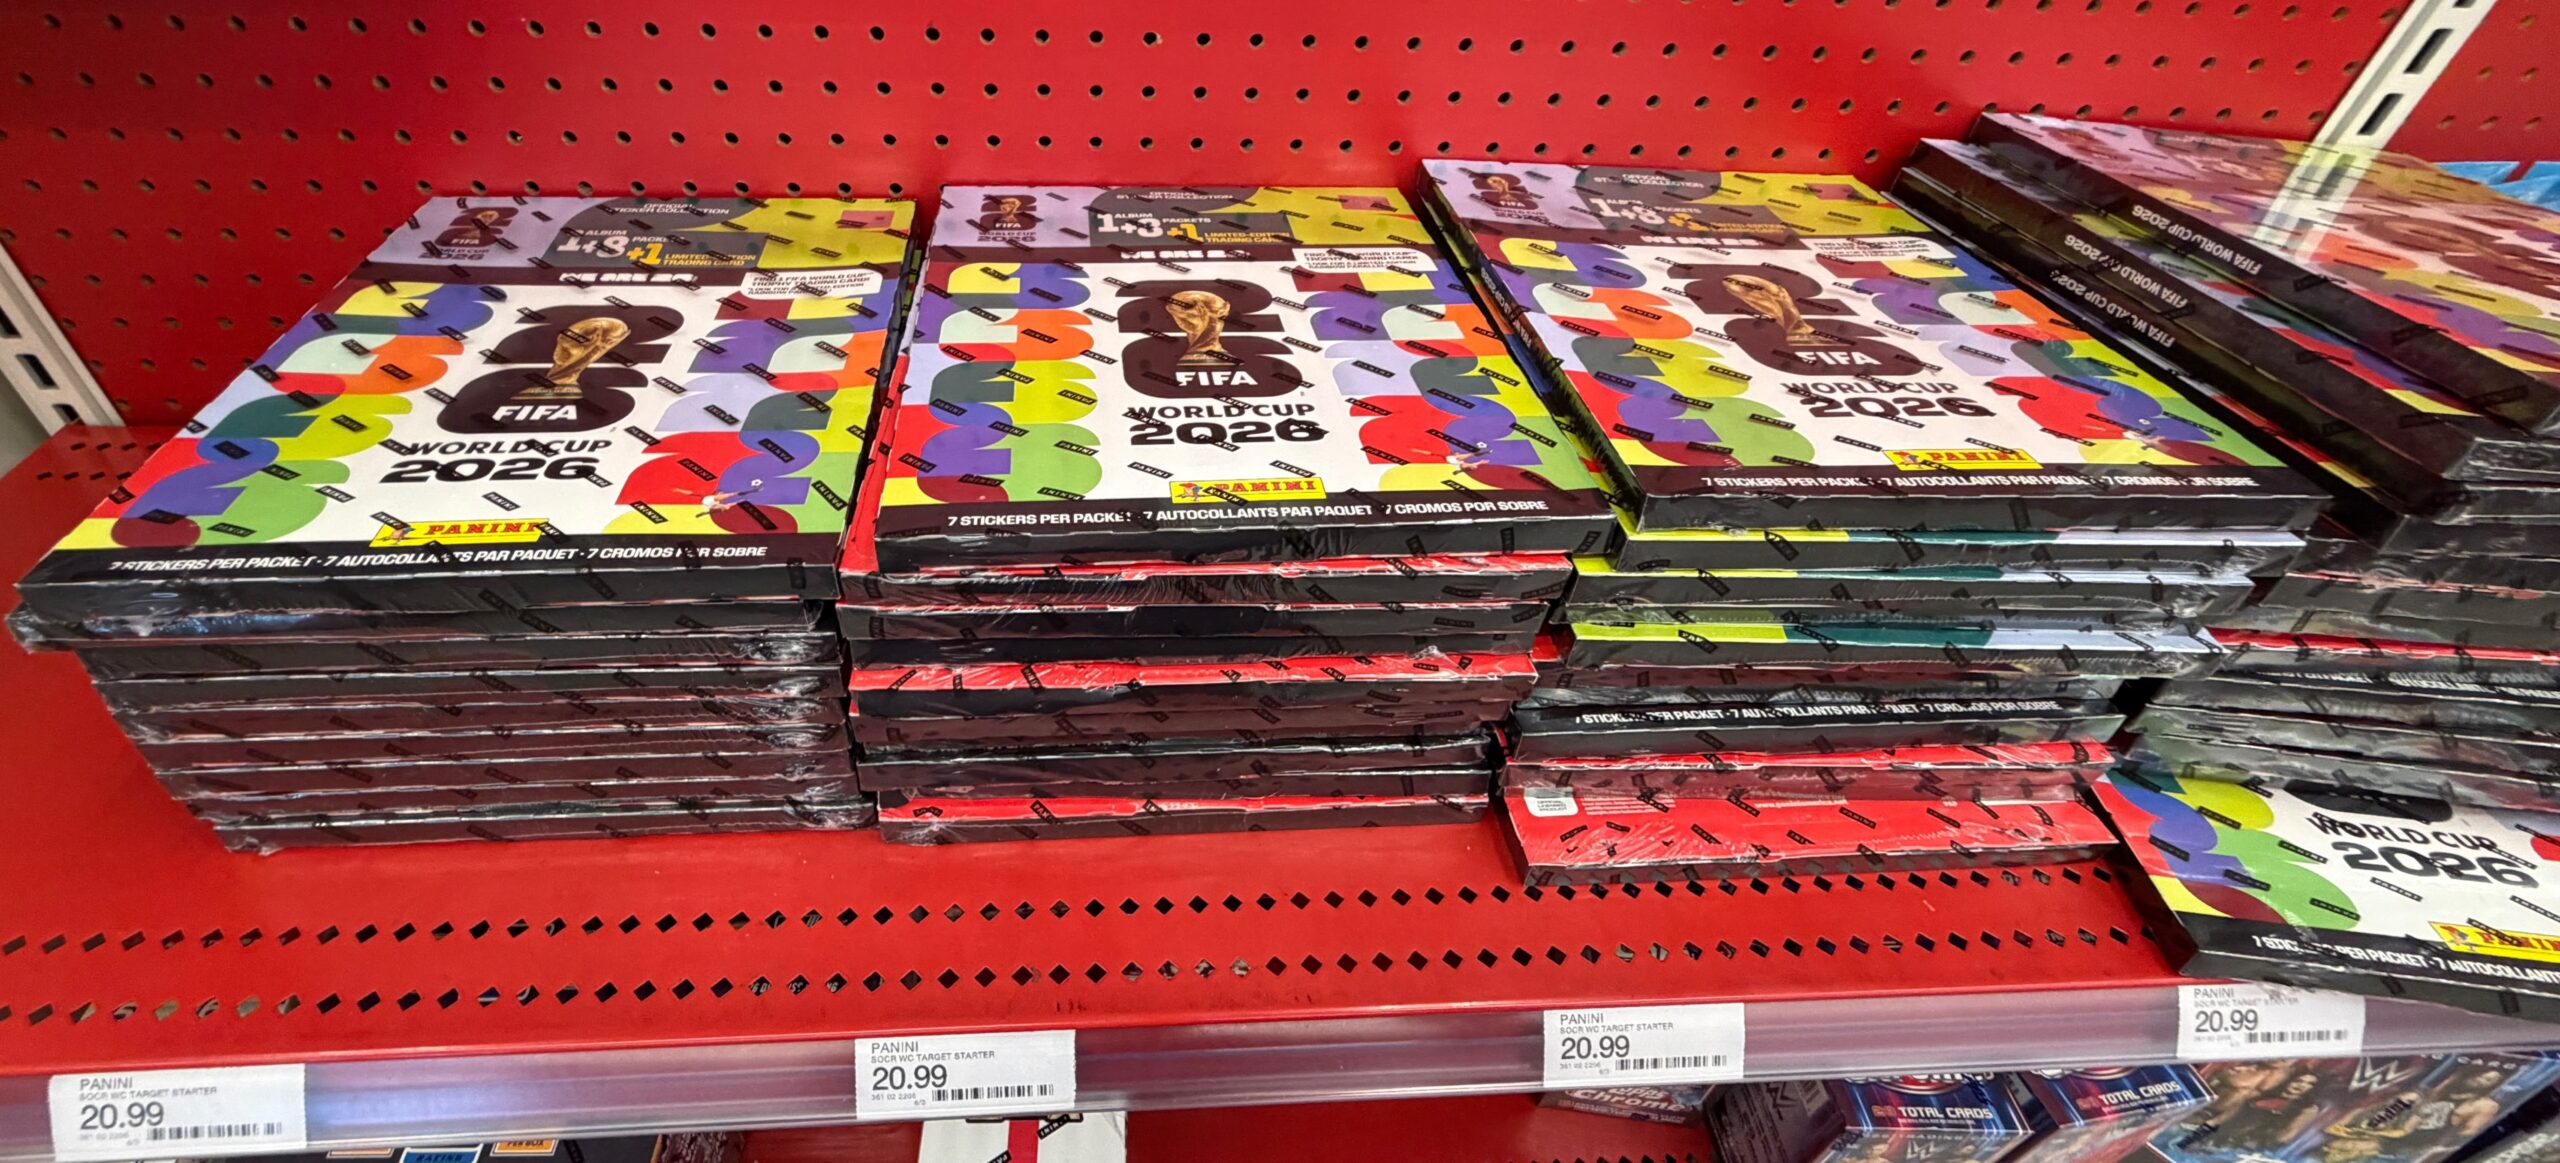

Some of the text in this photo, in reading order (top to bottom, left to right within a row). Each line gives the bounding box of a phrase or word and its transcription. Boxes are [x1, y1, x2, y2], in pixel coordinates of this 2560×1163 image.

[2131, 203, 2171, 230] 2026
[2167, 220, 2195, 242] CUP
[2063, 233, 2189, 310] FIFA WORLD 2026
[2232, 250, 2263, 276] FIFA
[2084, 289, 2109, 310] CUP
[2147, 326, 2176, 349] FIFA
[1794, 351, 1882, 366] FIFA
[1175, 371, 1259, 386] FIFA
[1482, 368, 1517, 386] PANINI
[1062, 390, 1094, 405] PANINI
[1781, 382, 1959, 395] WORLD CUP
[492, 405, 577, 420] FIFA
[1127, 404, 1316, 419] WORLD CUP
[1800, 397, 1993, 418] 2026
[1129, 420, 1328, 445] 2026
[1513, 423, 1554, 446] PANINI
[409, 440, 612, 455] WORLD CUP
[1058, 441, 1096, 456] PANINI
[1925, 451, 2029, 462] PANINI
[379, 457, 600, 483] 2026
[1131, 462, 1170, 478] PANINI
[1273, 461, 1313, 478] PANINI
[1214, 480, 1317, 493] PANINI
[1701, 477, 1712, 487] 7
[1712, 476, 1787, 487] STICKERS
[1787, 476, 1817, 487] PER
[1896, 475, 2011, 487] AUTOCOLLANTS
[2011, 475, 2042, 486] PAR
[2114, 475, 2177, 487] CROMOS
[814, 482, 845, 510] PANINI
[1041, 487, 1082, 501] PANINI
[634, 501, 664, 523] PANINI
[948, 516, 958, 527] 7
[960, 514, 1037, 526] STICKERS
[1040, 514, 1072, 525] PER
[1155, 507, 1279, 521] AUTOCOLLANTS
[1281, 506, 1313, 518] PAR
[1314, 504, 1373, 517] PAQUET
[1395, 502, 1464, 515] CROMOS
[1465, 501, 1497, 512] POR
[1498, 501, 1550, 512] SOBRE
[206, 556, 247, 569] PER
[327, 555, 338, 567] 7
[338, 551, 472, 566] AUTOCOLLATS
[473, 550, 510, 562] PAR
[511, 548, 579, 561] PAQUET
[586, 548, 600, 559] 7
[597, 547, 673, 559] CROMOS
[711, 546, 768, 557] SOBRE
[1674, 709, 1726, 721] PACKET
[1843, 705, 1867, 716] PAR
[1992, 702, 2017, 712] POR
[2017, 700, 2064, 711] SOBRE
[2306, 815, 2499, 851] WORLD CUP
[2331, 842, 2540, 889] 2026
[2368, 948, 2429, 969] PACKET
[2194, 988, 2234, 998] PANINI
[1560, 1013, 1604, 1025] PANINI
[1560, 1022, 1674, 1034] SOCR WC TARGET STARTER
[2195, 1009, 2259, 1033] 20.99
[871, 1041, 919, 1054] PANINI
[871, 1051, 995, 1063] SOCR WC TARGET STARTER
[1561, 1035, 1630, 1060] 20.99
[80, 1077, 133, 1091] PANINI
[872, 1064, 947, 1090] 20.99
[80, 1087, 217, 1101] SOCR WC TARGET STARTER
[1574, 1089, 1687, 1112] Chrome
[2099, 1088, 2140, 1106] TOTAL
[2141, 1080, 2183, 1098] CARDS
[80, 1101, 164, 1130] 20.99
[1898, 1106, 1944, 1119] TOTAL
[1946, 1106, 1994, 1120] CARDS
